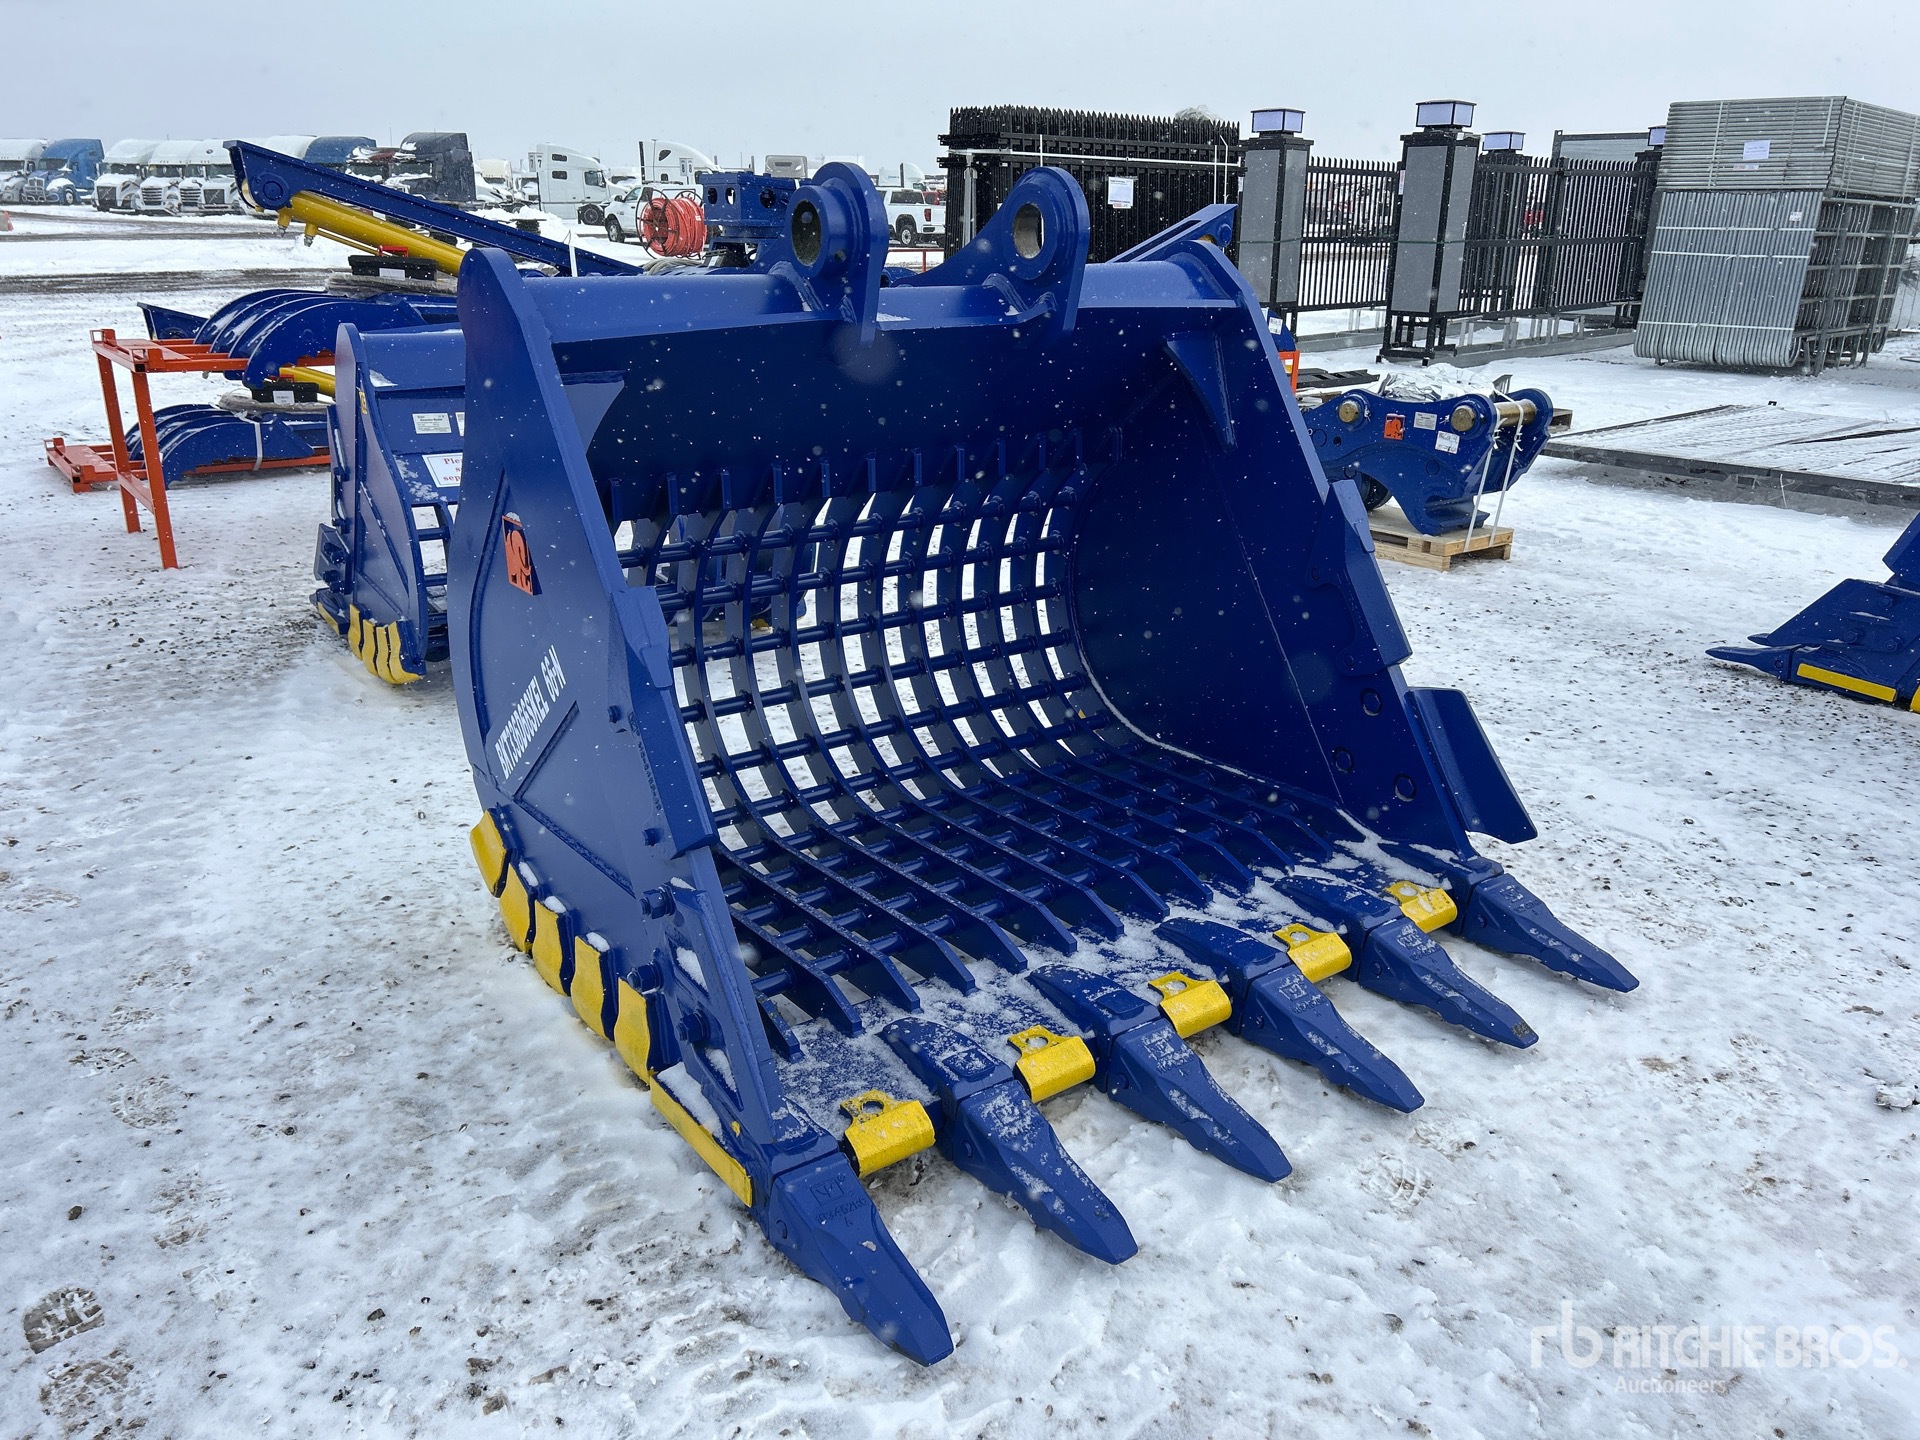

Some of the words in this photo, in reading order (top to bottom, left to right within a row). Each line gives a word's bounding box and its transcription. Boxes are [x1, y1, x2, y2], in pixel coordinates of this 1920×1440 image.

[443, 457, 461, 465] Ple
[494, 675, 550, 780] BKT336D66SKEL
[540, 644, 567, 703] 66-N
